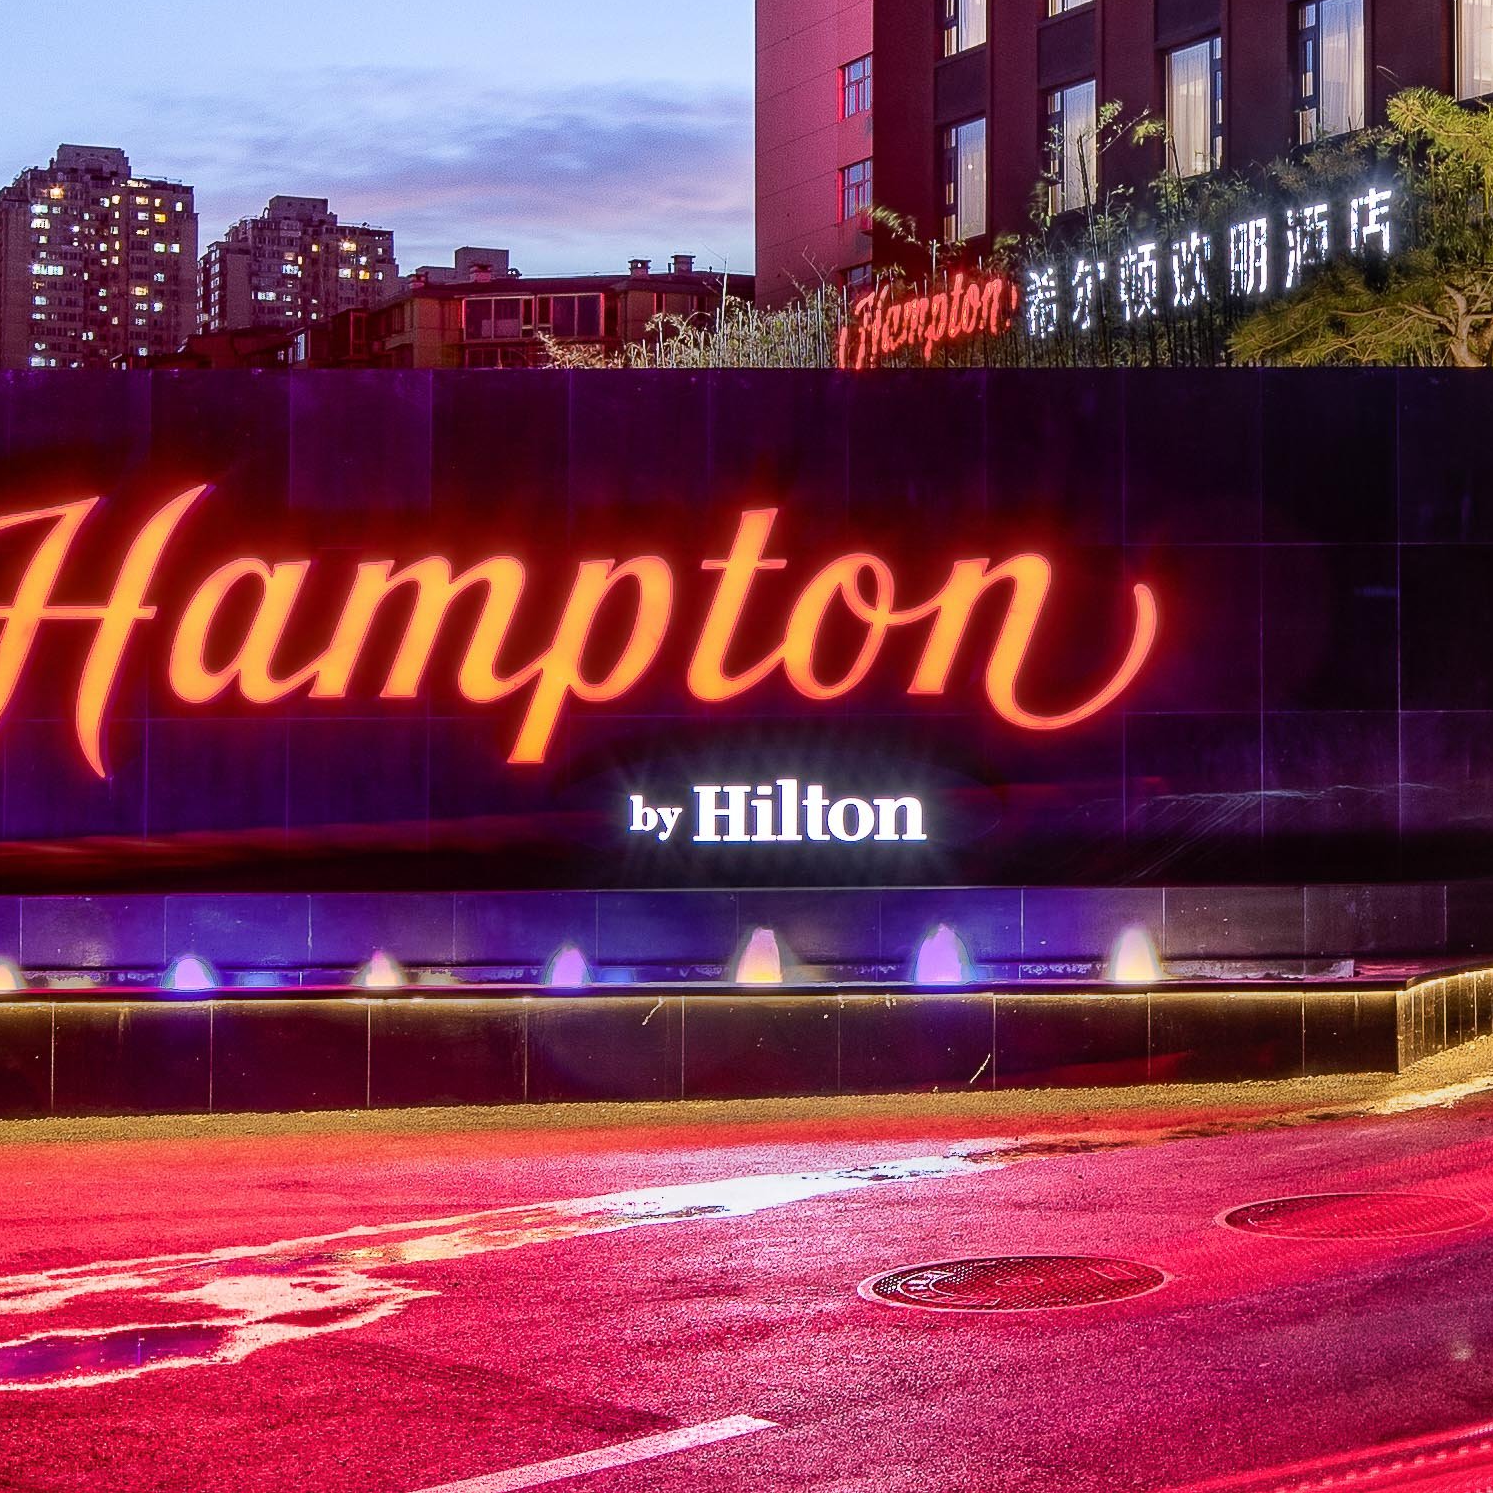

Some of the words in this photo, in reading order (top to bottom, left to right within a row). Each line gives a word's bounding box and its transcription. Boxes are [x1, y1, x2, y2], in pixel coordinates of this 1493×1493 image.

[838, 273, 1018, 369] Hampton
[629, 794, 683, 842] by
[692, 778, 928, 843] Hilton
